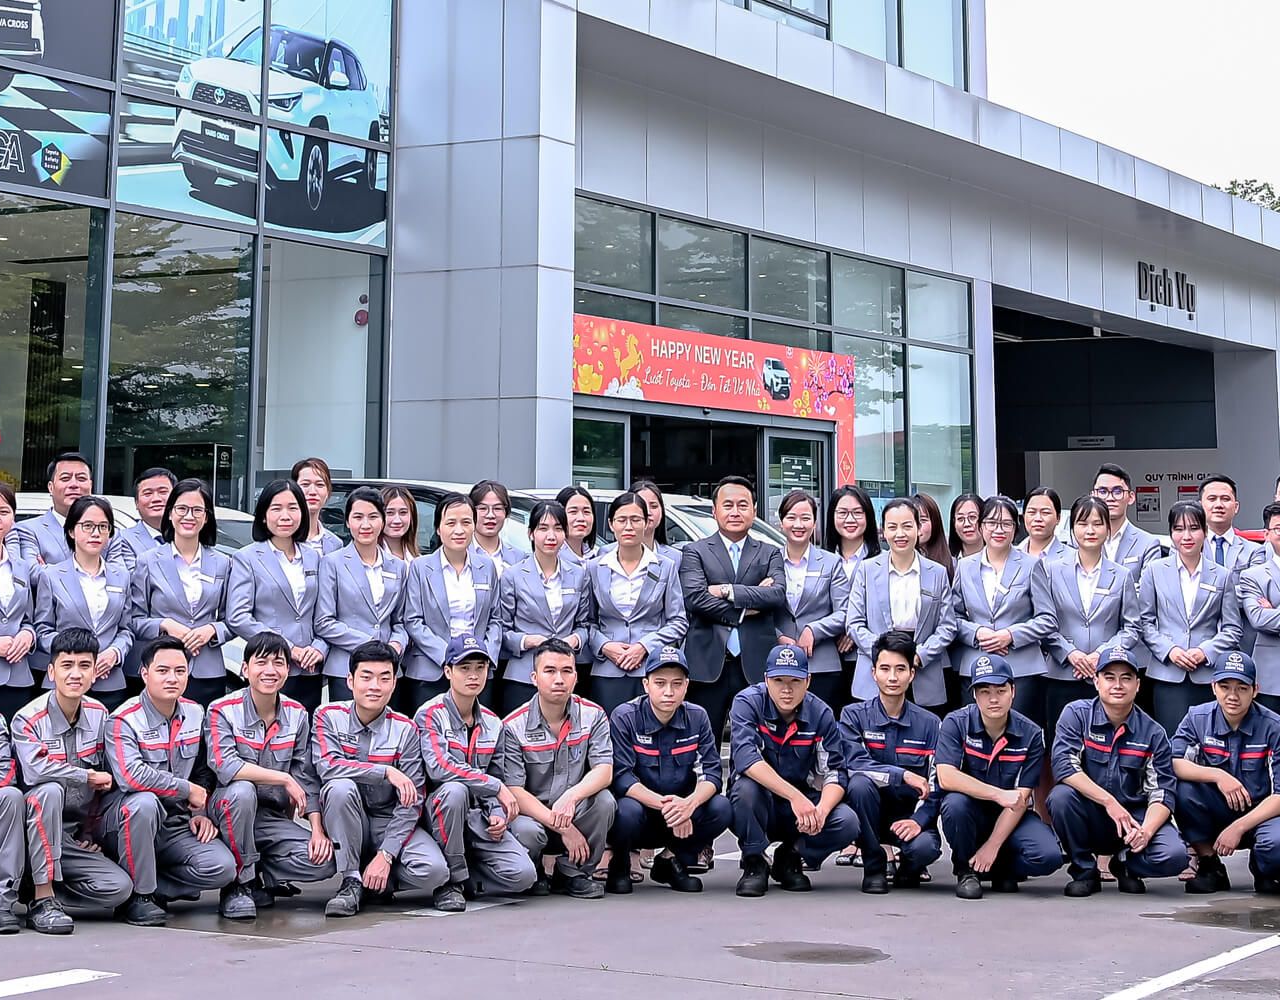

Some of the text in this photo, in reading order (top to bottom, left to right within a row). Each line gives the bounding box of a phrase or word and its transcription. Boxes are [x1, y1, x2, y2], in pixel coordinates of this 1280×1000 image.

[7, 19, 29, 30] CROSS
[1138, 261, 1196, 321] Dịch Vụ
[651, 338, 755, 371] HAPPY NEW YEAR
[665, 368, 691, 392] Toyota
[1145, 473, 1164, 482] QUY
[1167, 471, 1194, 481] TRÌNH
